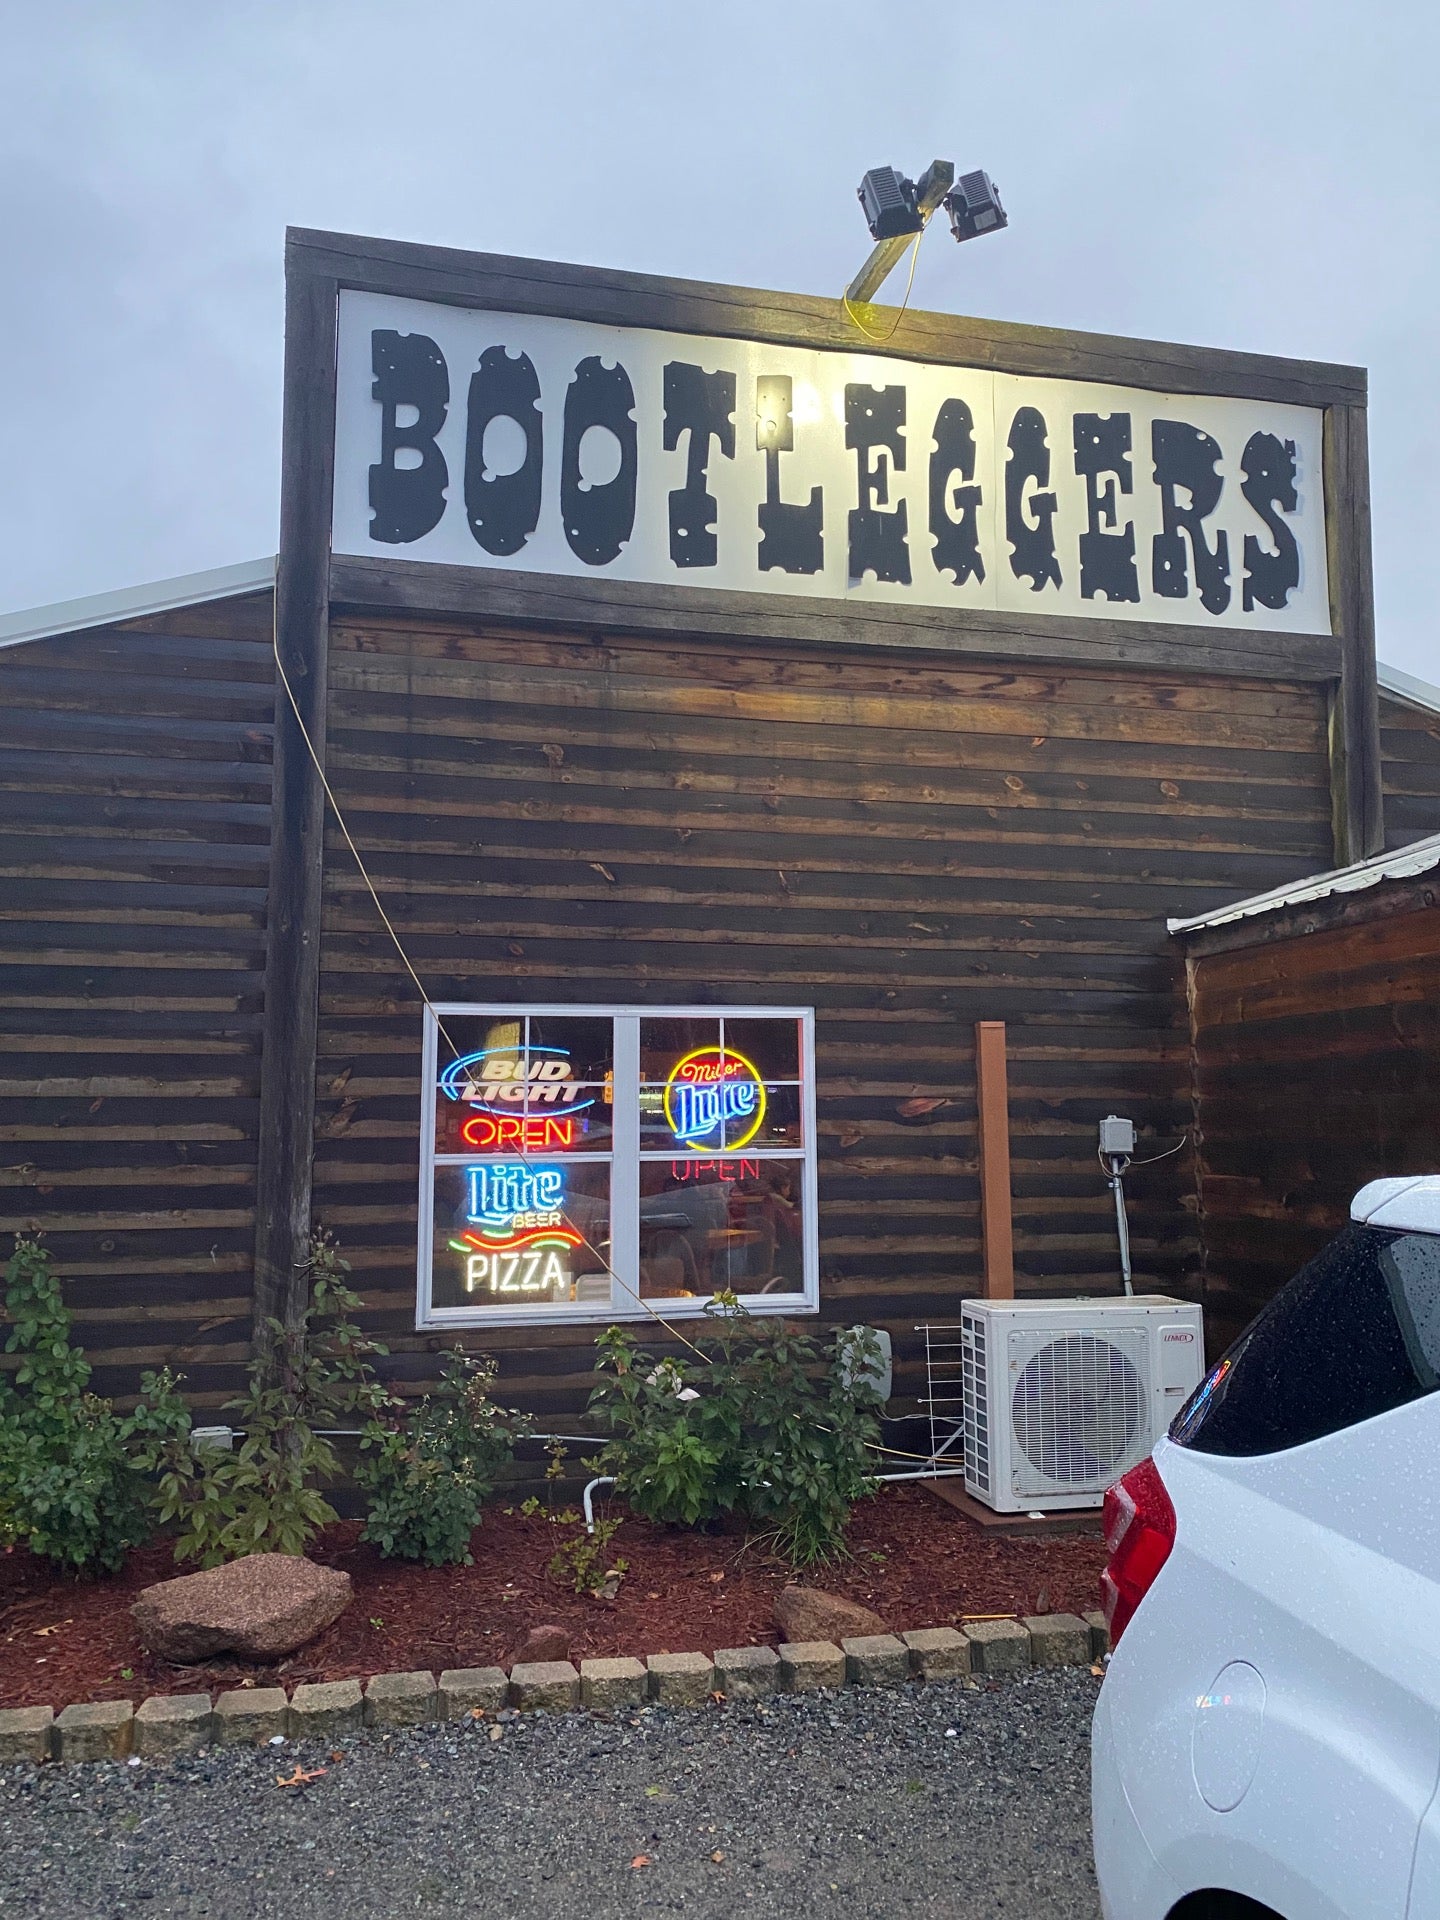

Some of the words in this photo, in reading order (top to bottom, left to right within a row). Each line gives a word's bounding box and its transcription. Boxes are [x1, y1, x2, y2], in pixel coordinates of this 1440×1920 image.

[368, 328, 1300, 616] BOOTLEGGERS
[481, 1060, 571, 1080] BUD
[461, 1080, 584, 1102] LIGHT
[462, 1116, 573, 1146] OPEN
[466, 1164, 564, 1226] Lite
[512, 1211, 562, 1228] BEER
[466, 1251, 566, 1292] PIZZA
[1163, 1333, 1190, 1343] LENNOX
